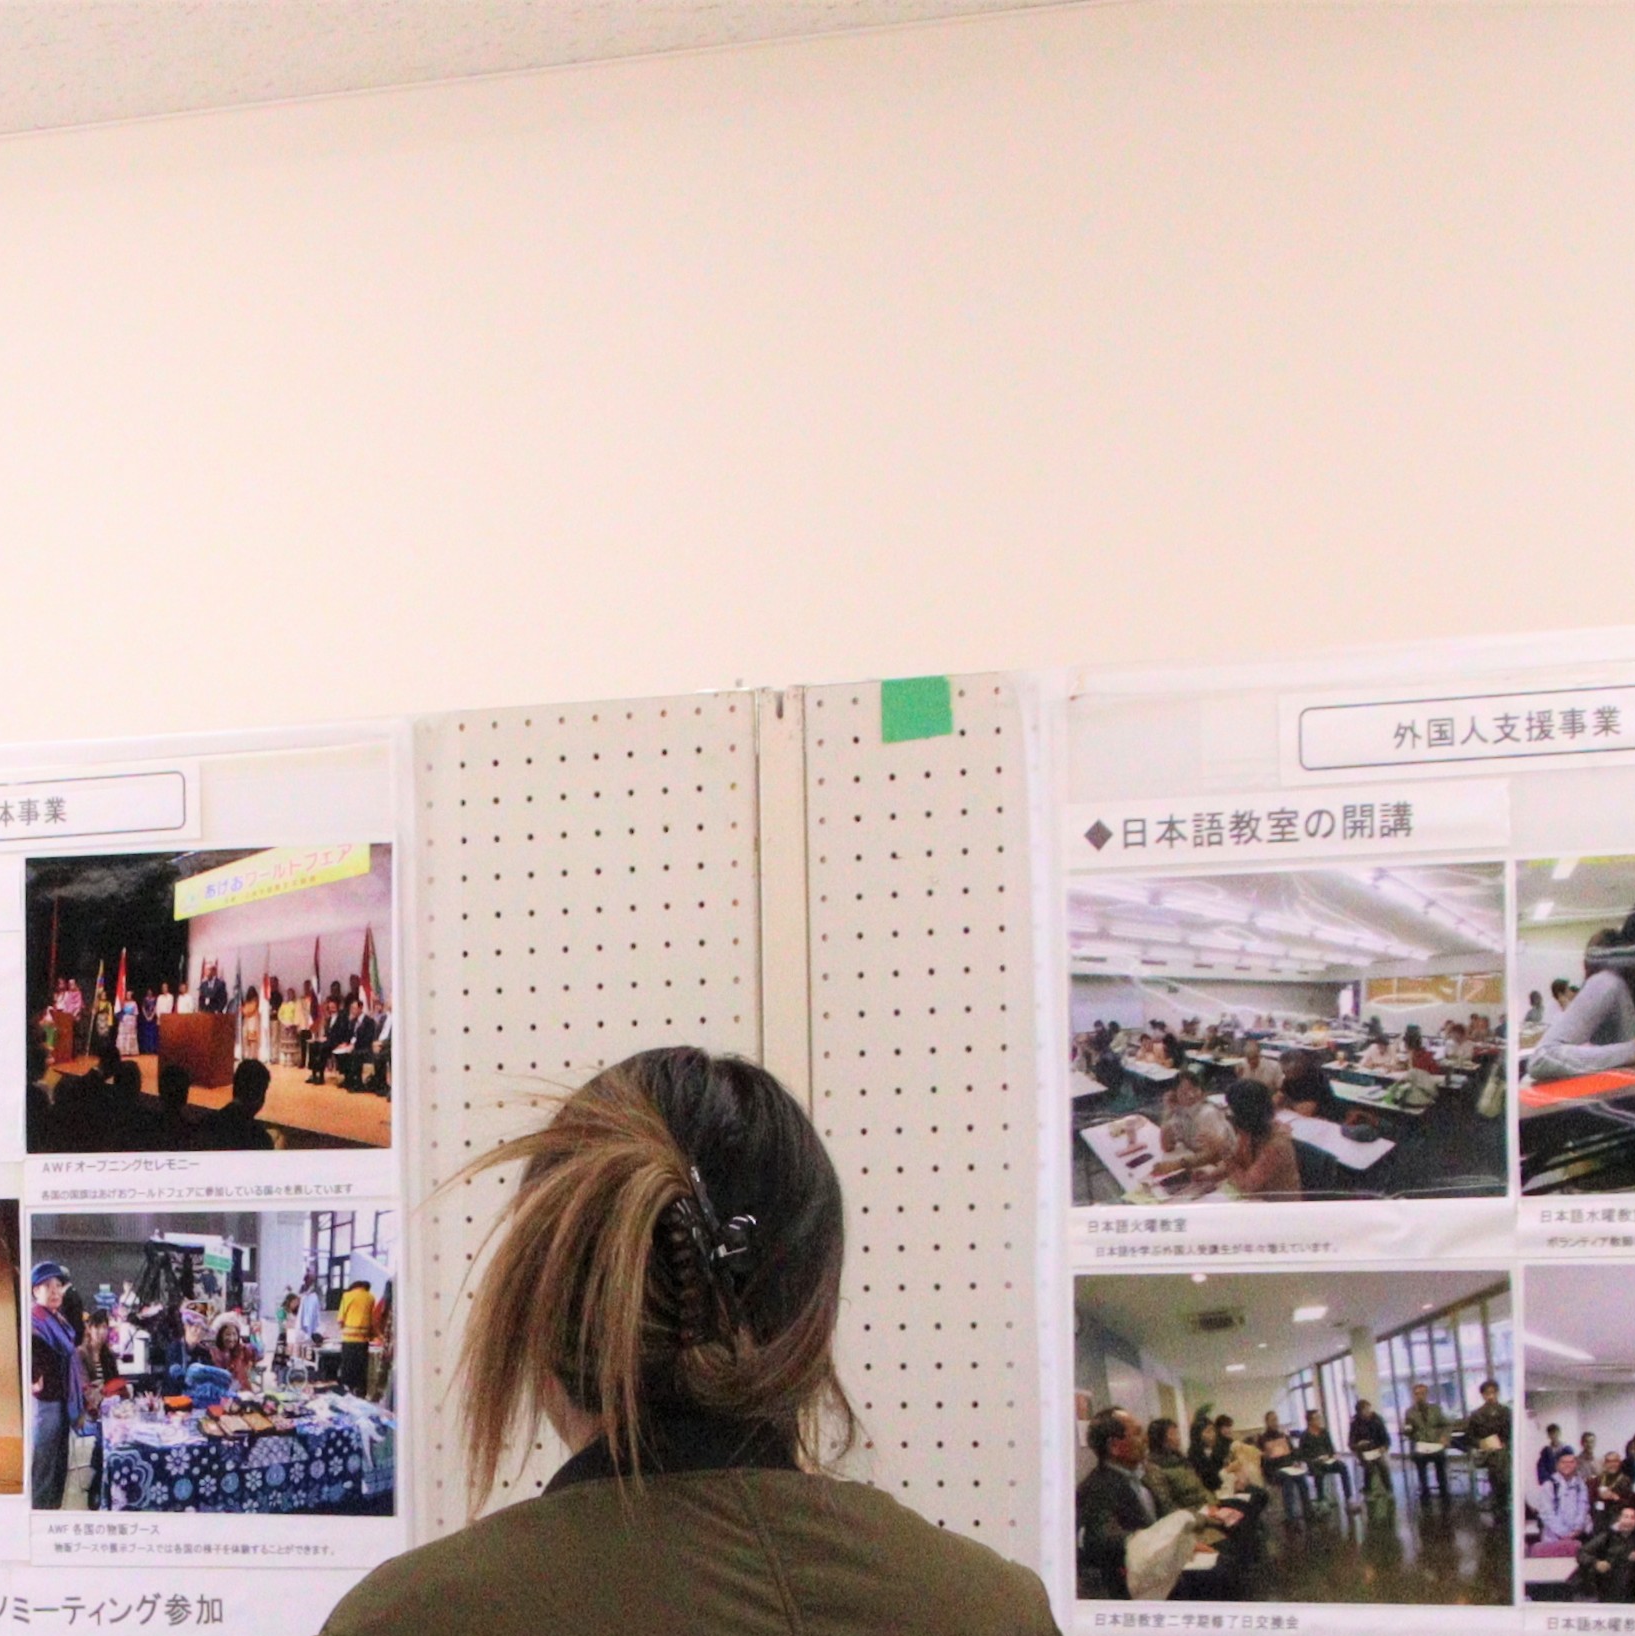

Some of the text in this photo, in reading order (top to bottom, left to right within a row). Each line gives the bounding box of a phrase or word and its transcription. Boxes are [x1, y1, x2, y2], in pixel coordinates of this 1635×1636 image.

[1393, 705, 1623, 751] 外国人支援事業
[1121, 803, 1415, 851] 日本語教室の開講
[1087, 1217, 1187, 1234] 日本語火曜教室
